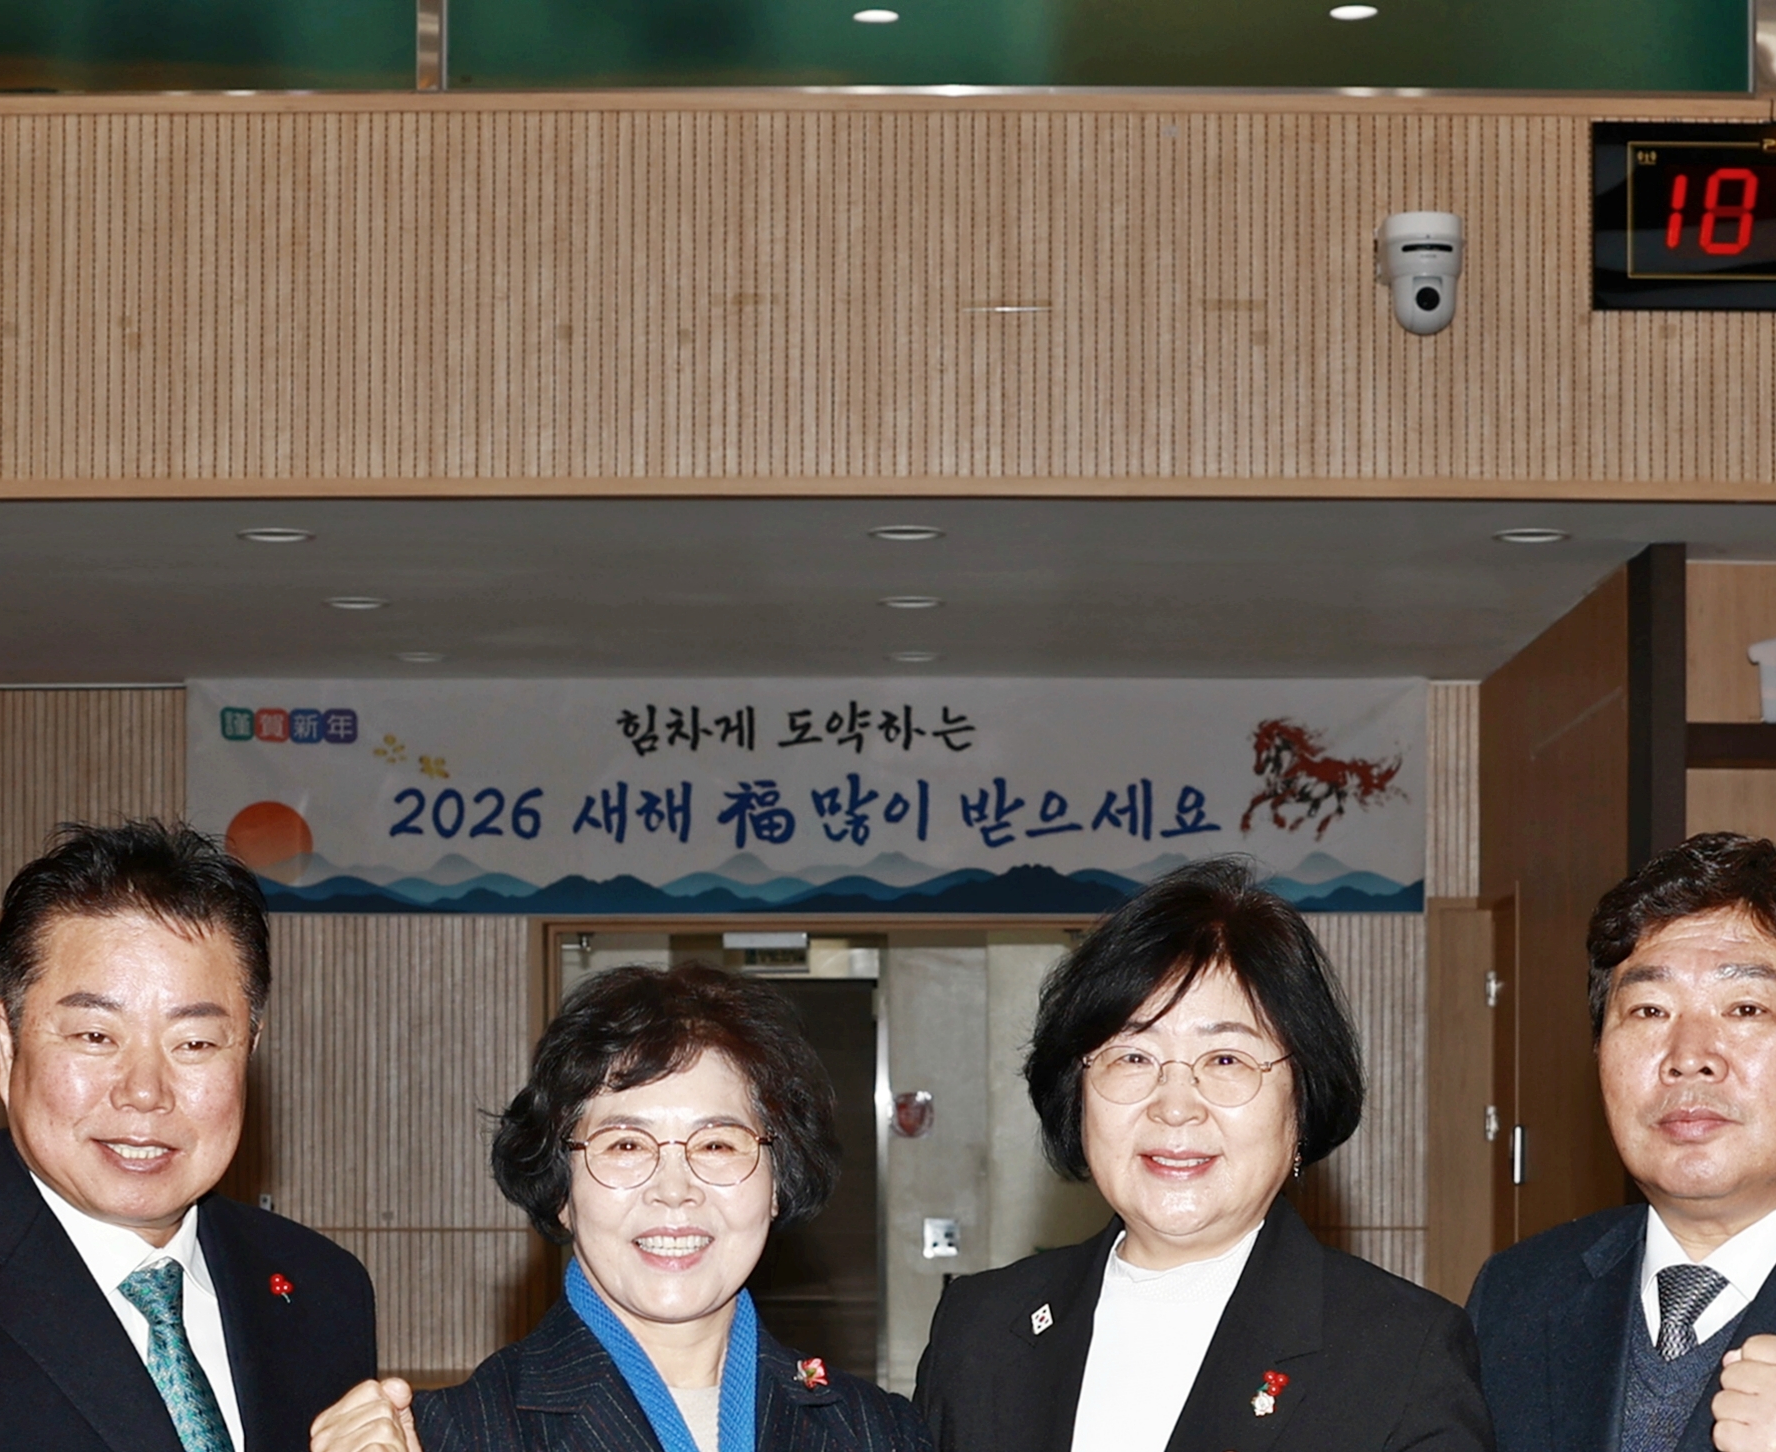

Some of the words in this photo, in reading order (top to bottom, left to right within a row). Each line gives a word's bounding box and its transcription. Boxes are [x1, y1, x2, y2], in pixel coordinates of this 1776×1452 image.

[1665, 168, 1759, 256] 10
[223, 710, 355, 741] 謹賀新年
[616, 702, 757, 757] 힘차게
[777, 700, 977, 755] 도약하는
[388, 786, 544, 841] 2026
[572, 780, 693, 845] 새해
[717, 779, 794, 849] 福
[810, 772, 930, 847] 많이
[960, 776, 1223, 850] 받으세요
